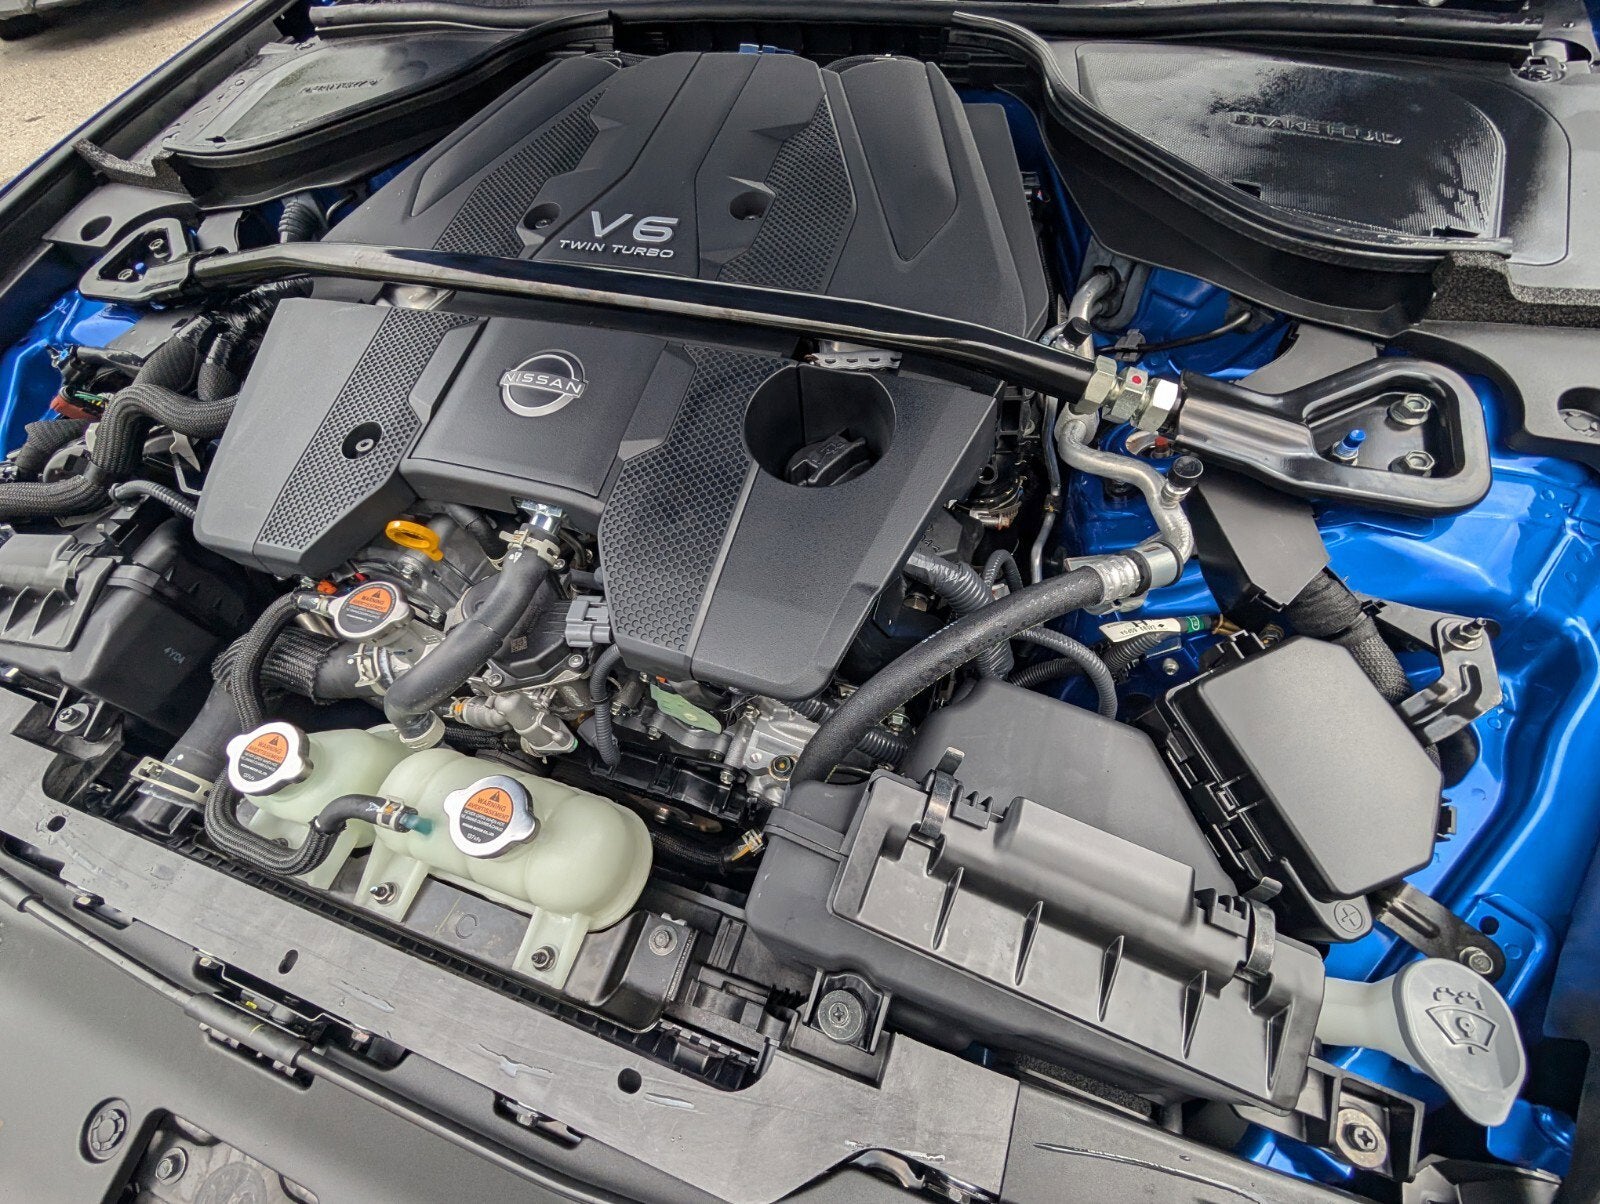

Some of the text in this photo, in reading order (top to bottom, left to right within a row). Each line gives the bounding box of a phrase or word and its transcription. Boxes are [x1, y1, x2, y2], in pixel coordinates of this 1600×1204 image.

[1234, 113, 1402, 145] BRAKE FLUID
[591, 210, 679, 243] V6
[560, 239, 675, 258] TWIN TURBO
[503, 373, 582, 394] NISSAN
[258, 741, 282, 754] WARNING
[467, 802, 510, 821] AVERTISSEMENT
[477, 798, 507, 812] WARNING
